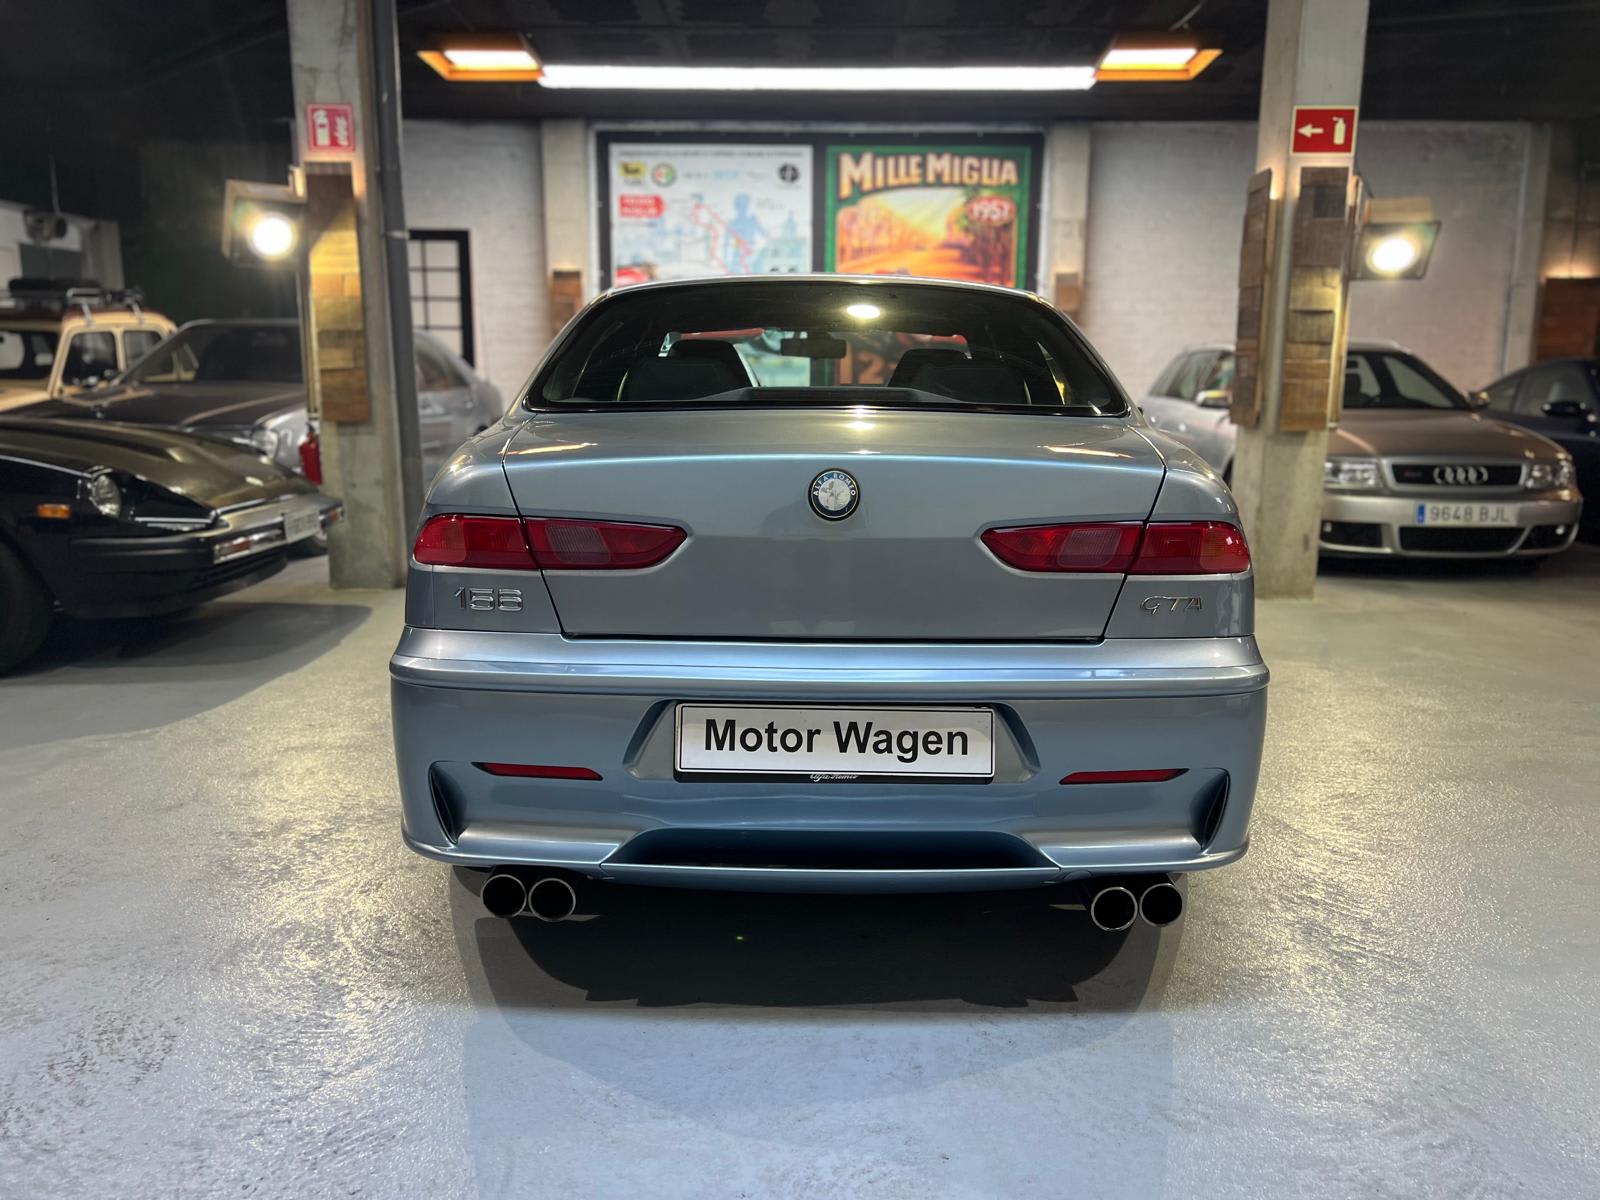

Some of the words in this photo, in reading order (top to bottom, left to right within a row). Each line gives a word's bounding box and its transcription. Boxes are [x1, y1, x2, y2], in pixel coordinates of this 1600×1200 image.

[839, 152, 922, 199] MILLE
[926, 153, 1018, 186] MIGLIA
[813, 476, 829, 496] ALFA
[833, 473, 856, 496] ROMEO
[1430, 506, 1473, 522] 9648
[1480, 507, 1509, 522] BJL
[1141, 595, 1202, 614] GTA
[704, 719, 822, 753] Motor
[833, 721, 968, 763] Wagen
